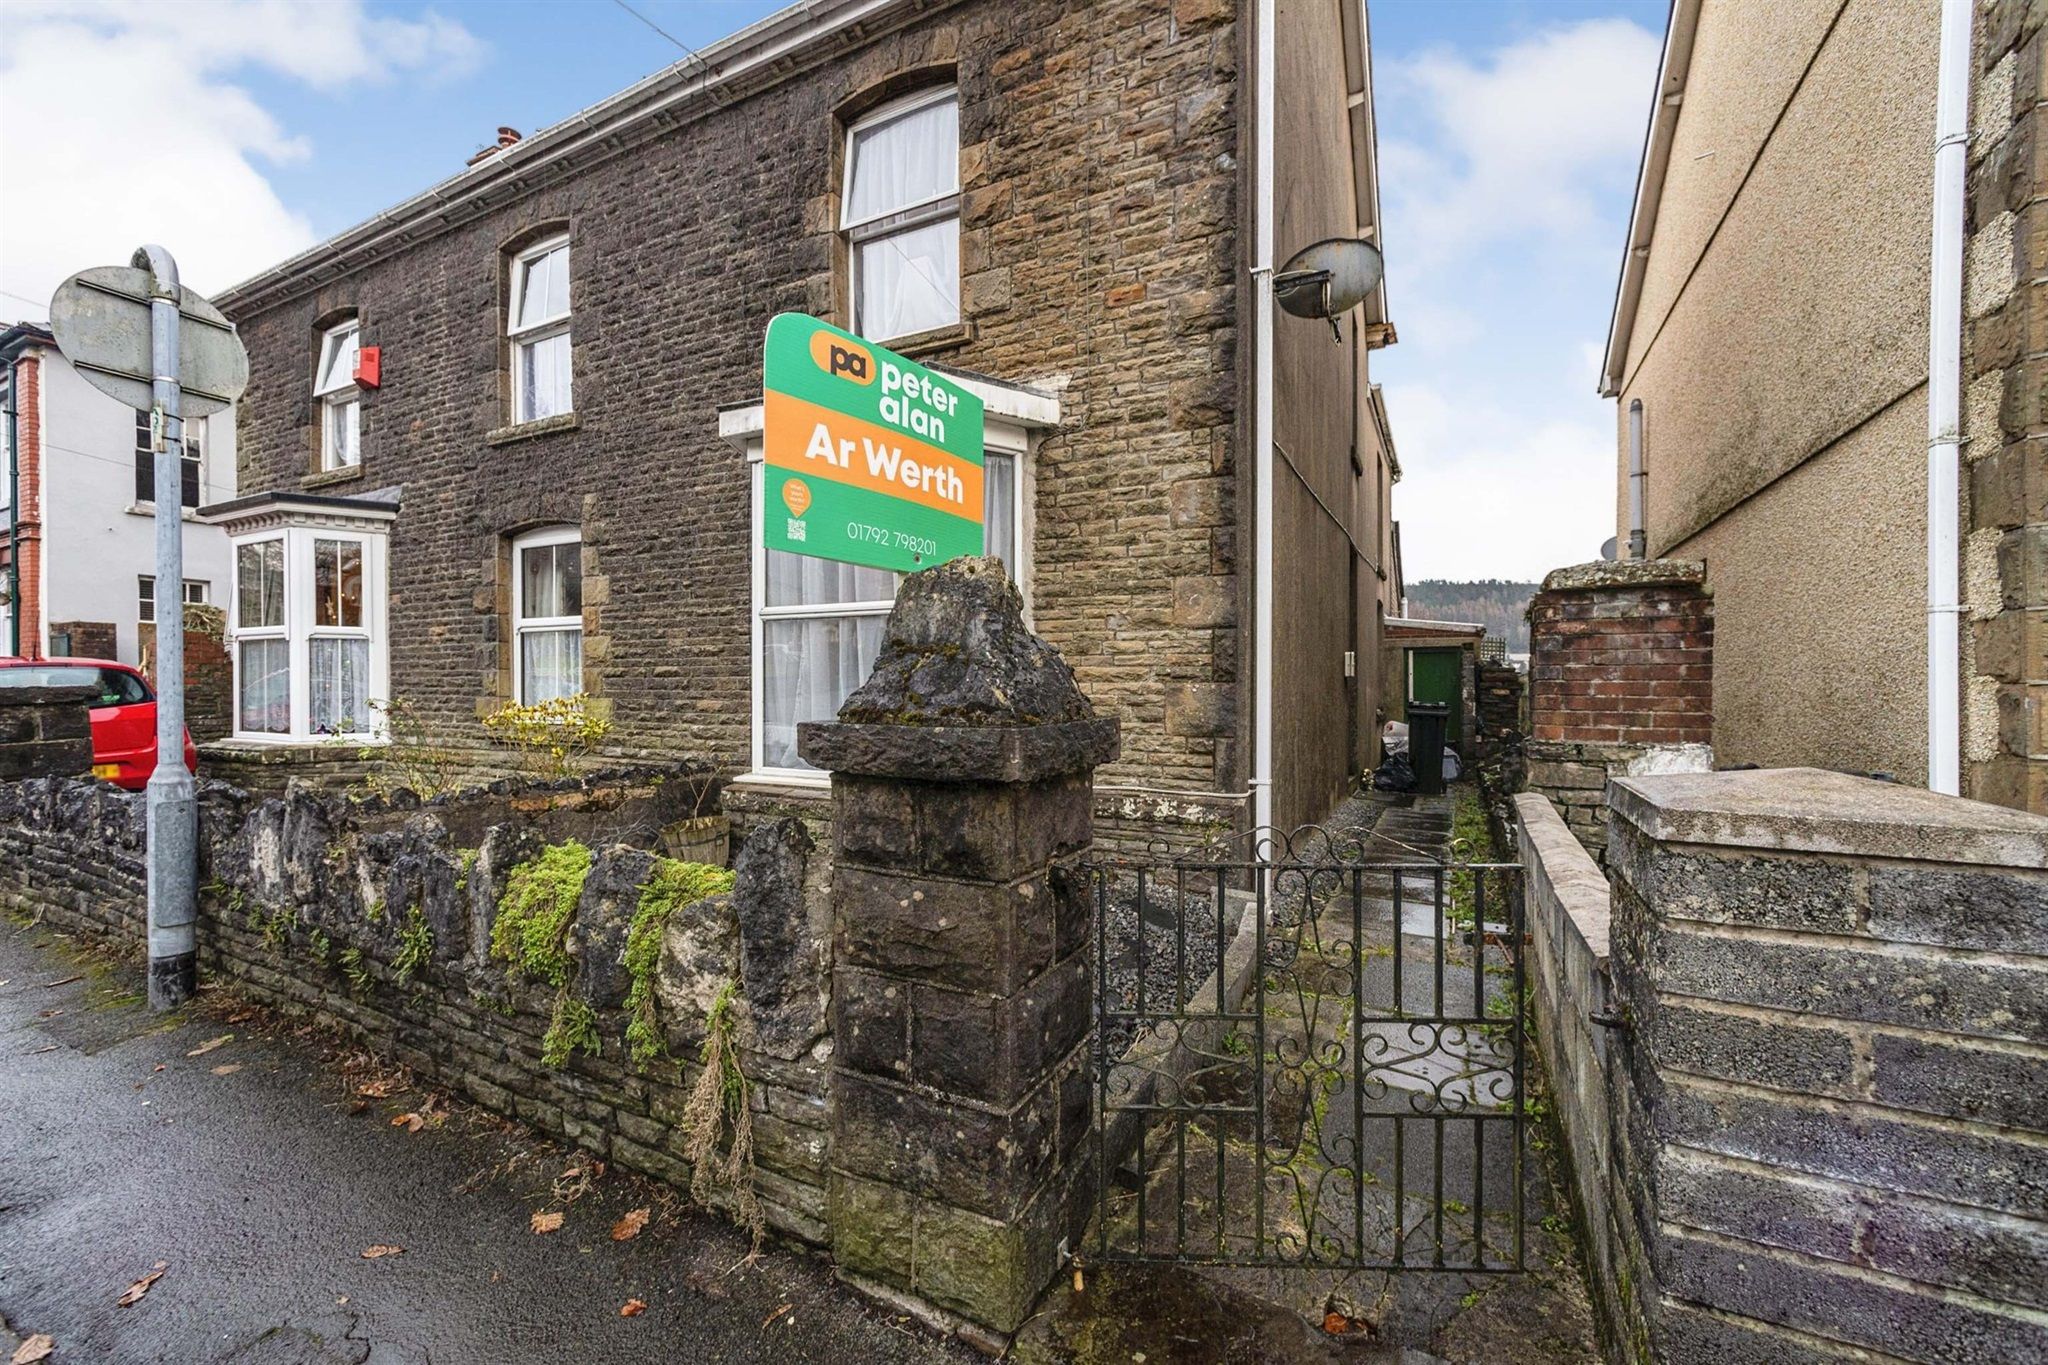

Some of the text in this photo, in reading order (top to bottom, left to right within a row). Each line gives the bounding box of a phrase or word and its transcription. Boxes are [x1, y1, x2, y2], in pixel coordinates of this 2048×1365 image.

[830, 345, 866, 379] pa
[881, 360, 958, 417] peter
[879, 396, 944, 443] alan
[805, 423, 963, 504] Ar Werth
[847, 522, 936, 556] 01792 798201
